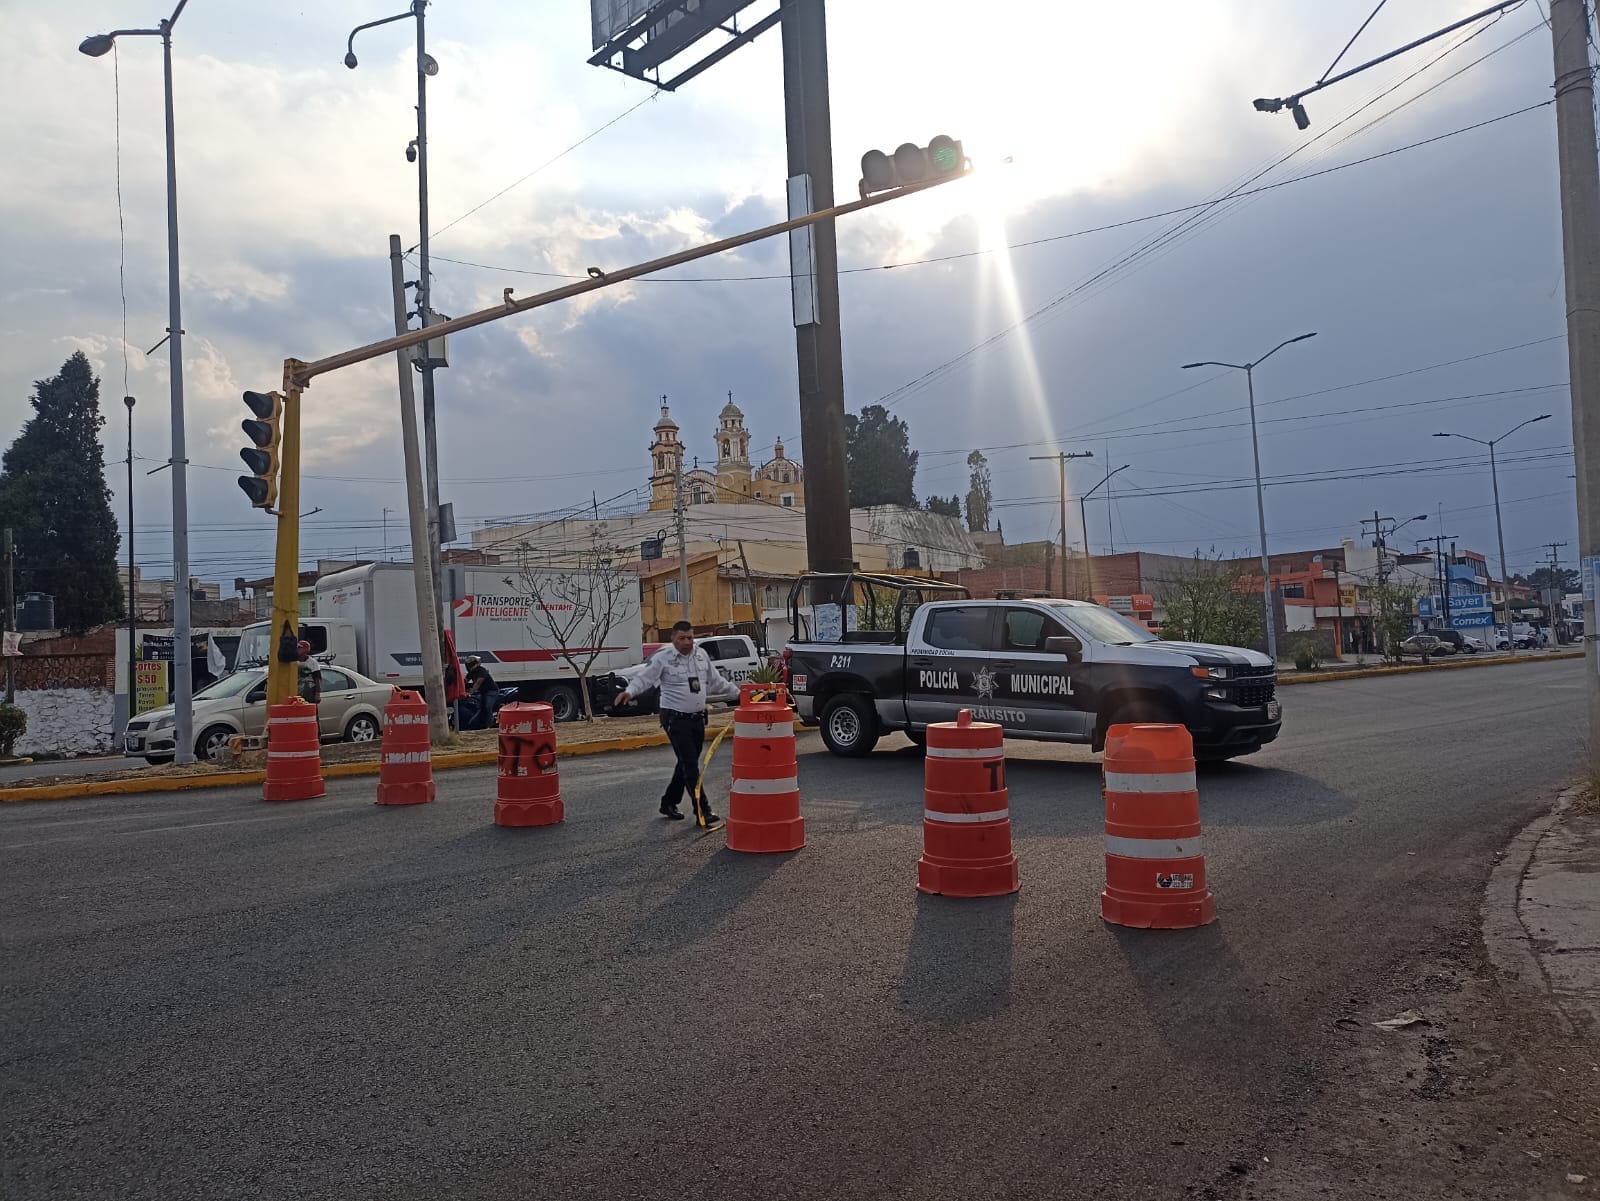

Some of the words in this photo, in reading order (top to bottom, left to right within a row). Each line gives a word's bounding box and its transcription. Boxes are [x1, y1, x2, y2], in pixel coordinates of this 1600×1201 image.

[477, 595, 530, 606] TRANSPORTE
[1448, 596, 1479, 608] Sayer
[476, 606, 529, 617] INTELIGENTE
[1452, 615, 1489, 626] Comex
[831, 655, 851, 668] P-211
[920, 668, 959, 689] POLICÍA
[1010, 674, 1075, 696] MUNICIPAL
